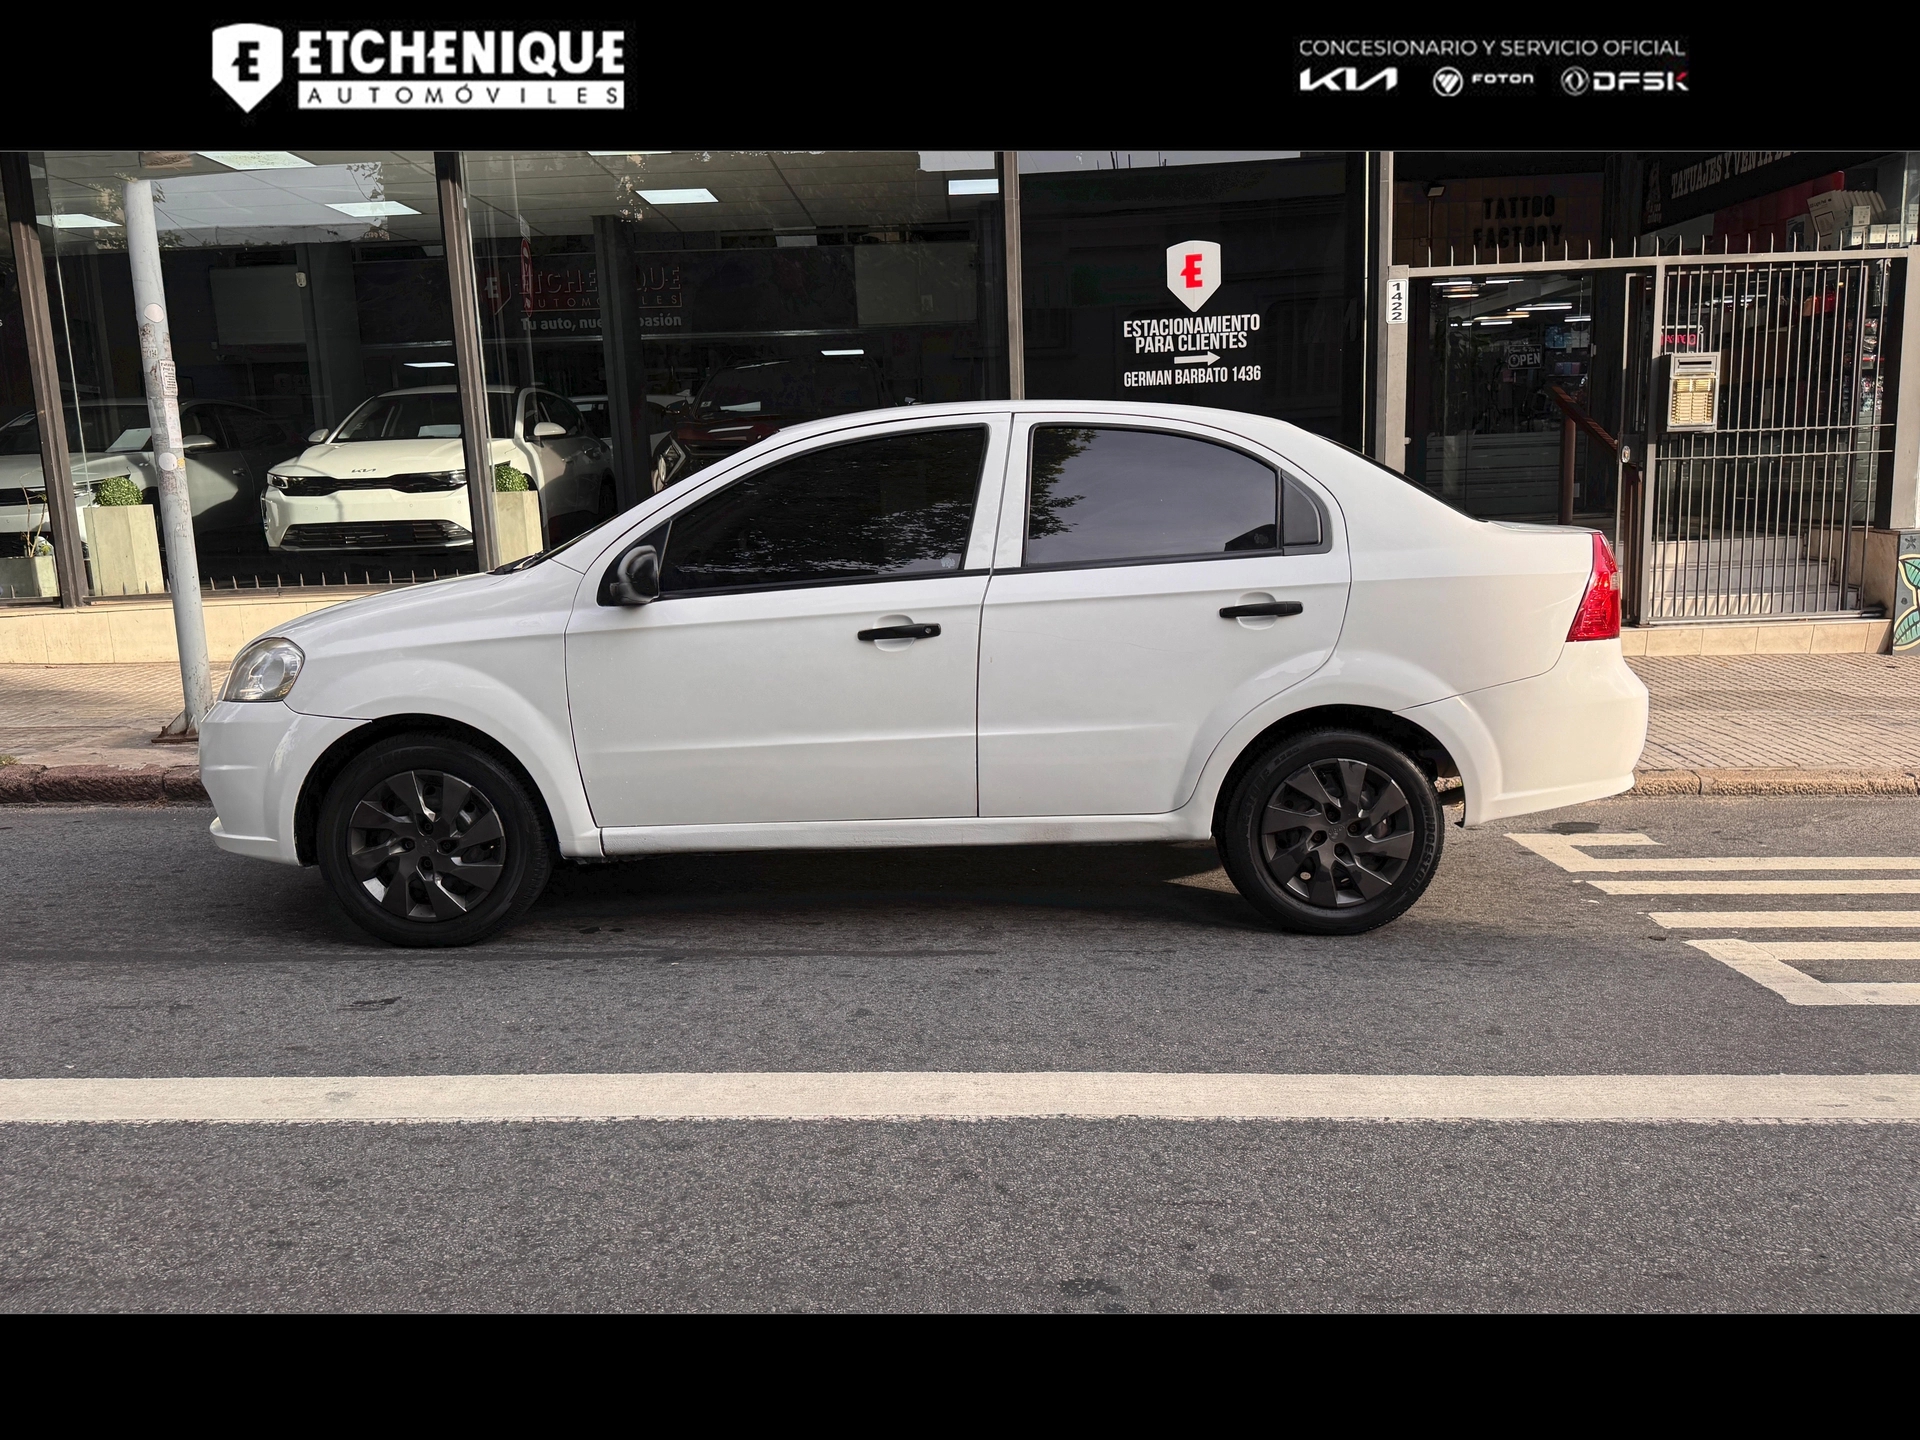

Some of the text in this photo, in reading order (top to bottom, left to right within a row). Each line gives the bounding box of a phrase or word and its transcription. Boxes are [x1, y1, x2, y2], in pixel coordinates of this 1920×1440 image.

[1671, 154, 1722, 200] TATUAJES
[1483, 195, 1555, 219] TATTOO
[1473, 224, 1562, 249] FACTORY
[1391, 282, 1403, 321] 1422
[1123, 313, 1261, 338] ESTACIONAMIENTO
[1135, 331, 1248, 354] PARA CLIENTES
[1508, 352, 1541, 367] OPEN
[1124, 365, 1262, 387] GERMAN BARBATO 1436
